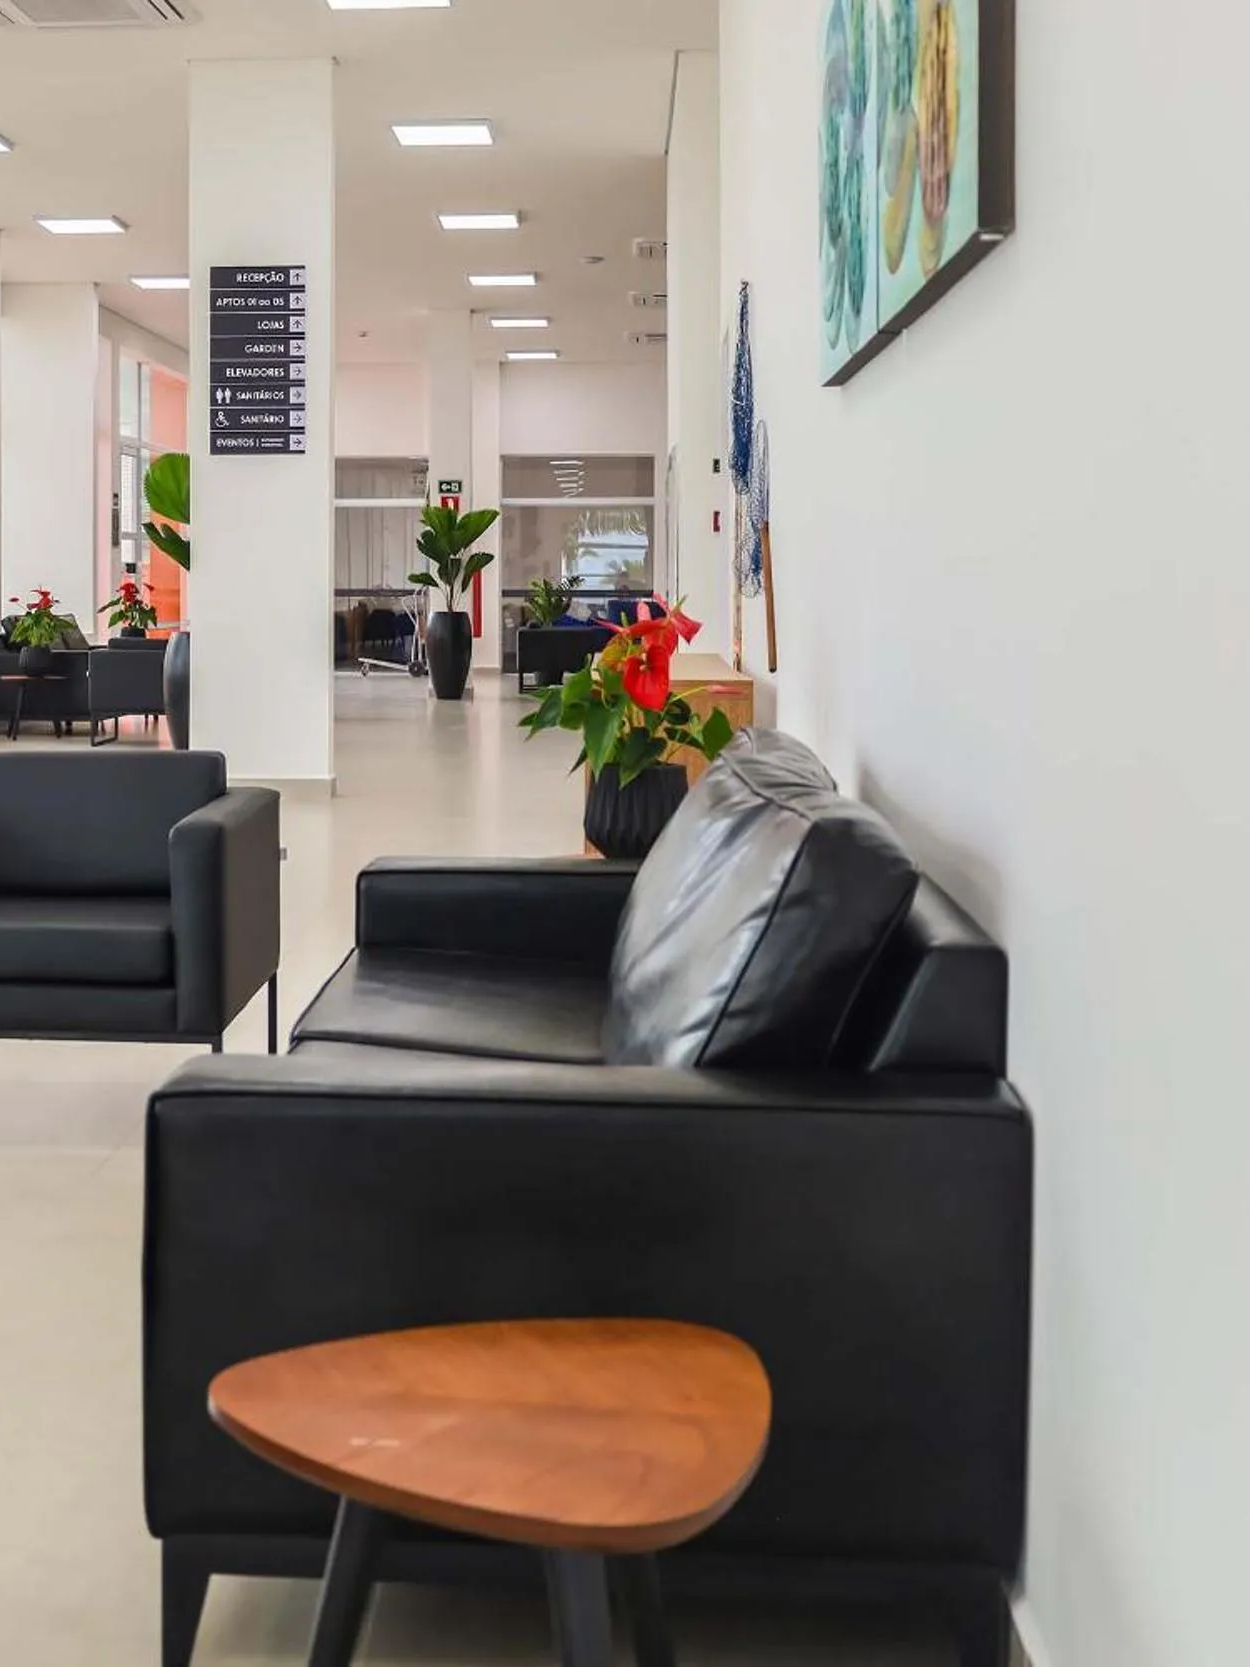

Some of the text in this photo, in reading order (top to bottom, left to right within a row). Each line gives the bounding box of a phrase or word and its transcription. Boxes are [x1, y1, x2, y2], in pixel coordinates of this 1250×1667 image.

[236, 271, 285, 283] RECEPÇÃO
[216, 298, 245, 306] APTOS
[257, 320, 284, 329] LOJAS
[245, 344, 284, 353] GARDEN
[226, 367, 284, 377] ELEVADORES
[236, 390, 284, 400] SANITÁRIOS
[240, 413, 284, 424] SANITÁRIO
[216, 438, 254, 447] EVENTOS
